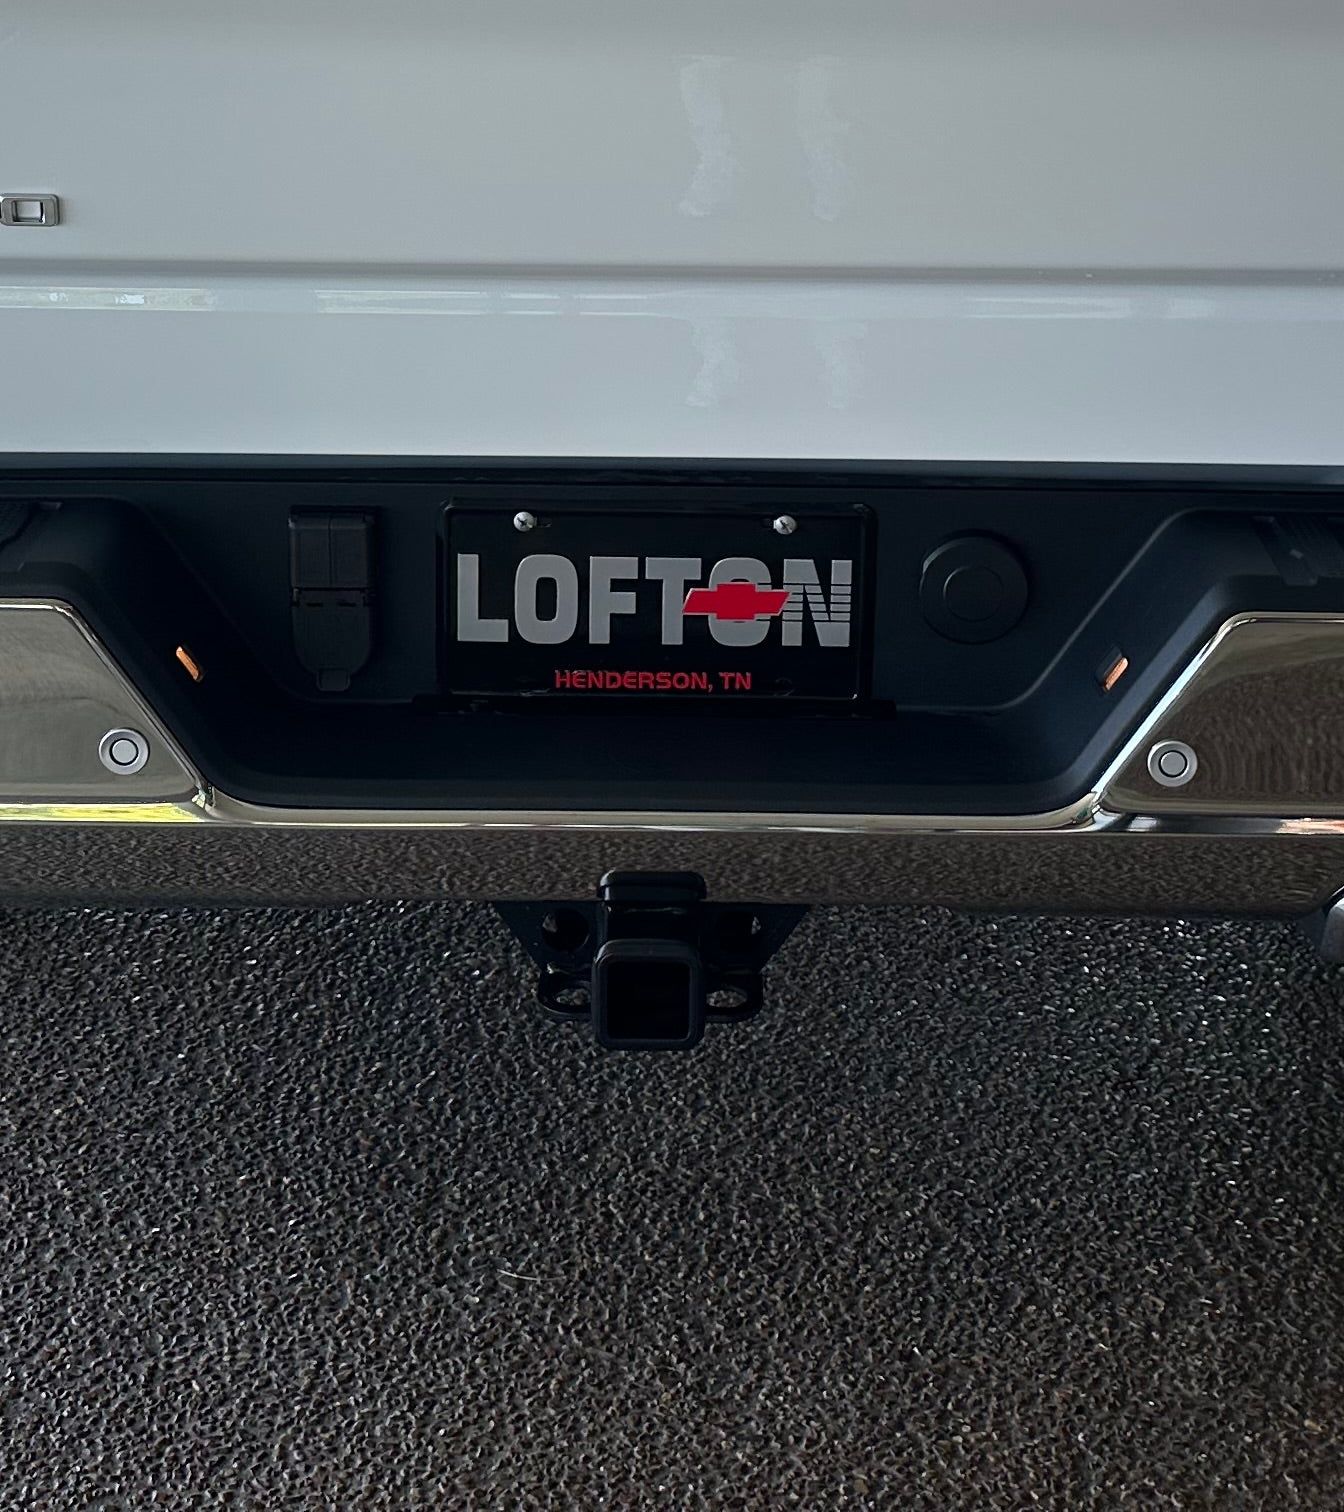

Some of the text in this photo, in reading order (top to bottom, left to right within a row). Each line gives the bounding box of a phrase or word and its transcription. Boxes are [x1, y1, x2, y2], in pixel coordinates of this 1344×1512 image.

[457, 553, 852, 648] LOFTON
[554, 669, 752, 693] HENDERSON, TN
